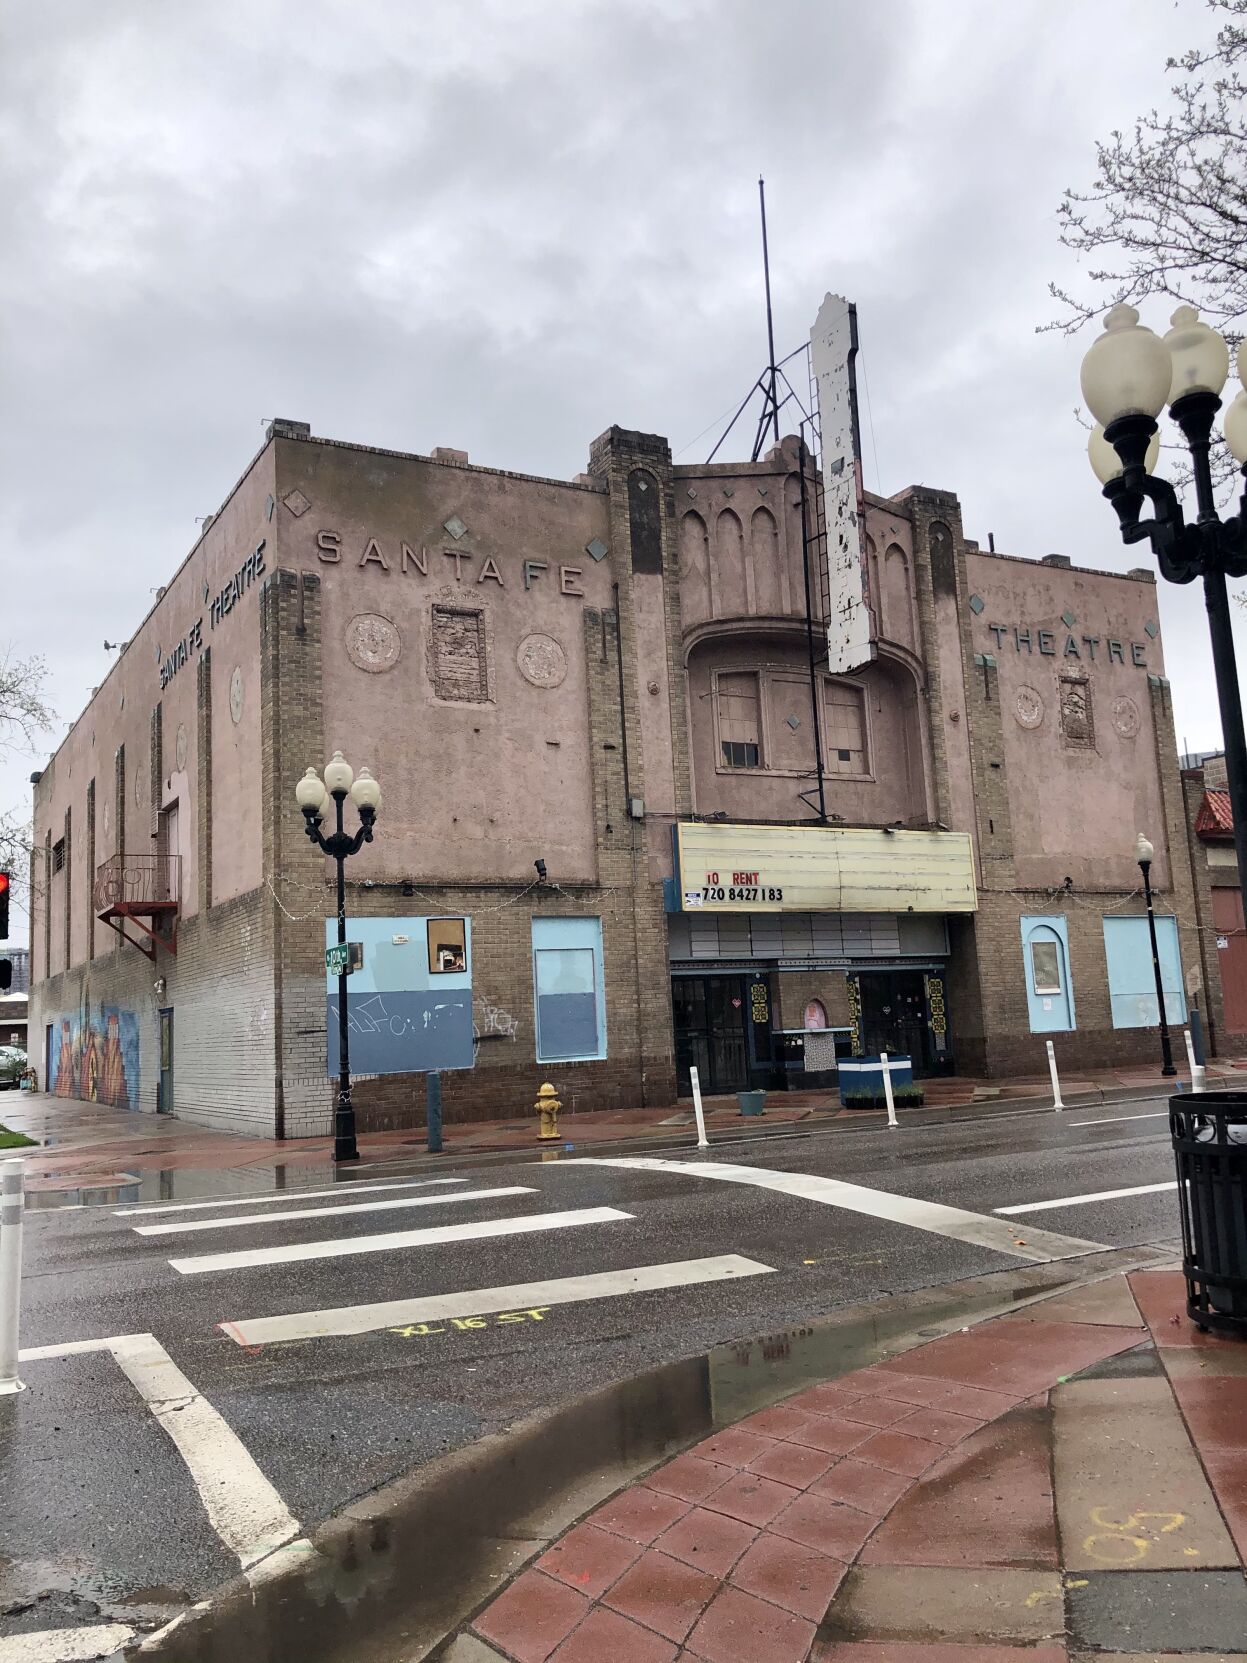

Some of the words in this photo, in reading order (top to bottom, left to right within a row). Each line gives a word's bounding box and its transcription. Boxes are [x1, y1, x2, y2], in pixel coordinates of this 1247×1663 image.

[316, 529, 504, 586] SANTA
[523, 559, 584, 597] FE
[160, 638, 188, 690] SANTA
[189, 617, 203, 655] FE
[208, 538, 267, 631] THEATRE
[988, 623, 1148, 667] THEATRE
[732, 872, 759, 885] RENT
[702, 887, 725, 901] 720
[451, 1316, 487, 1330] 16
